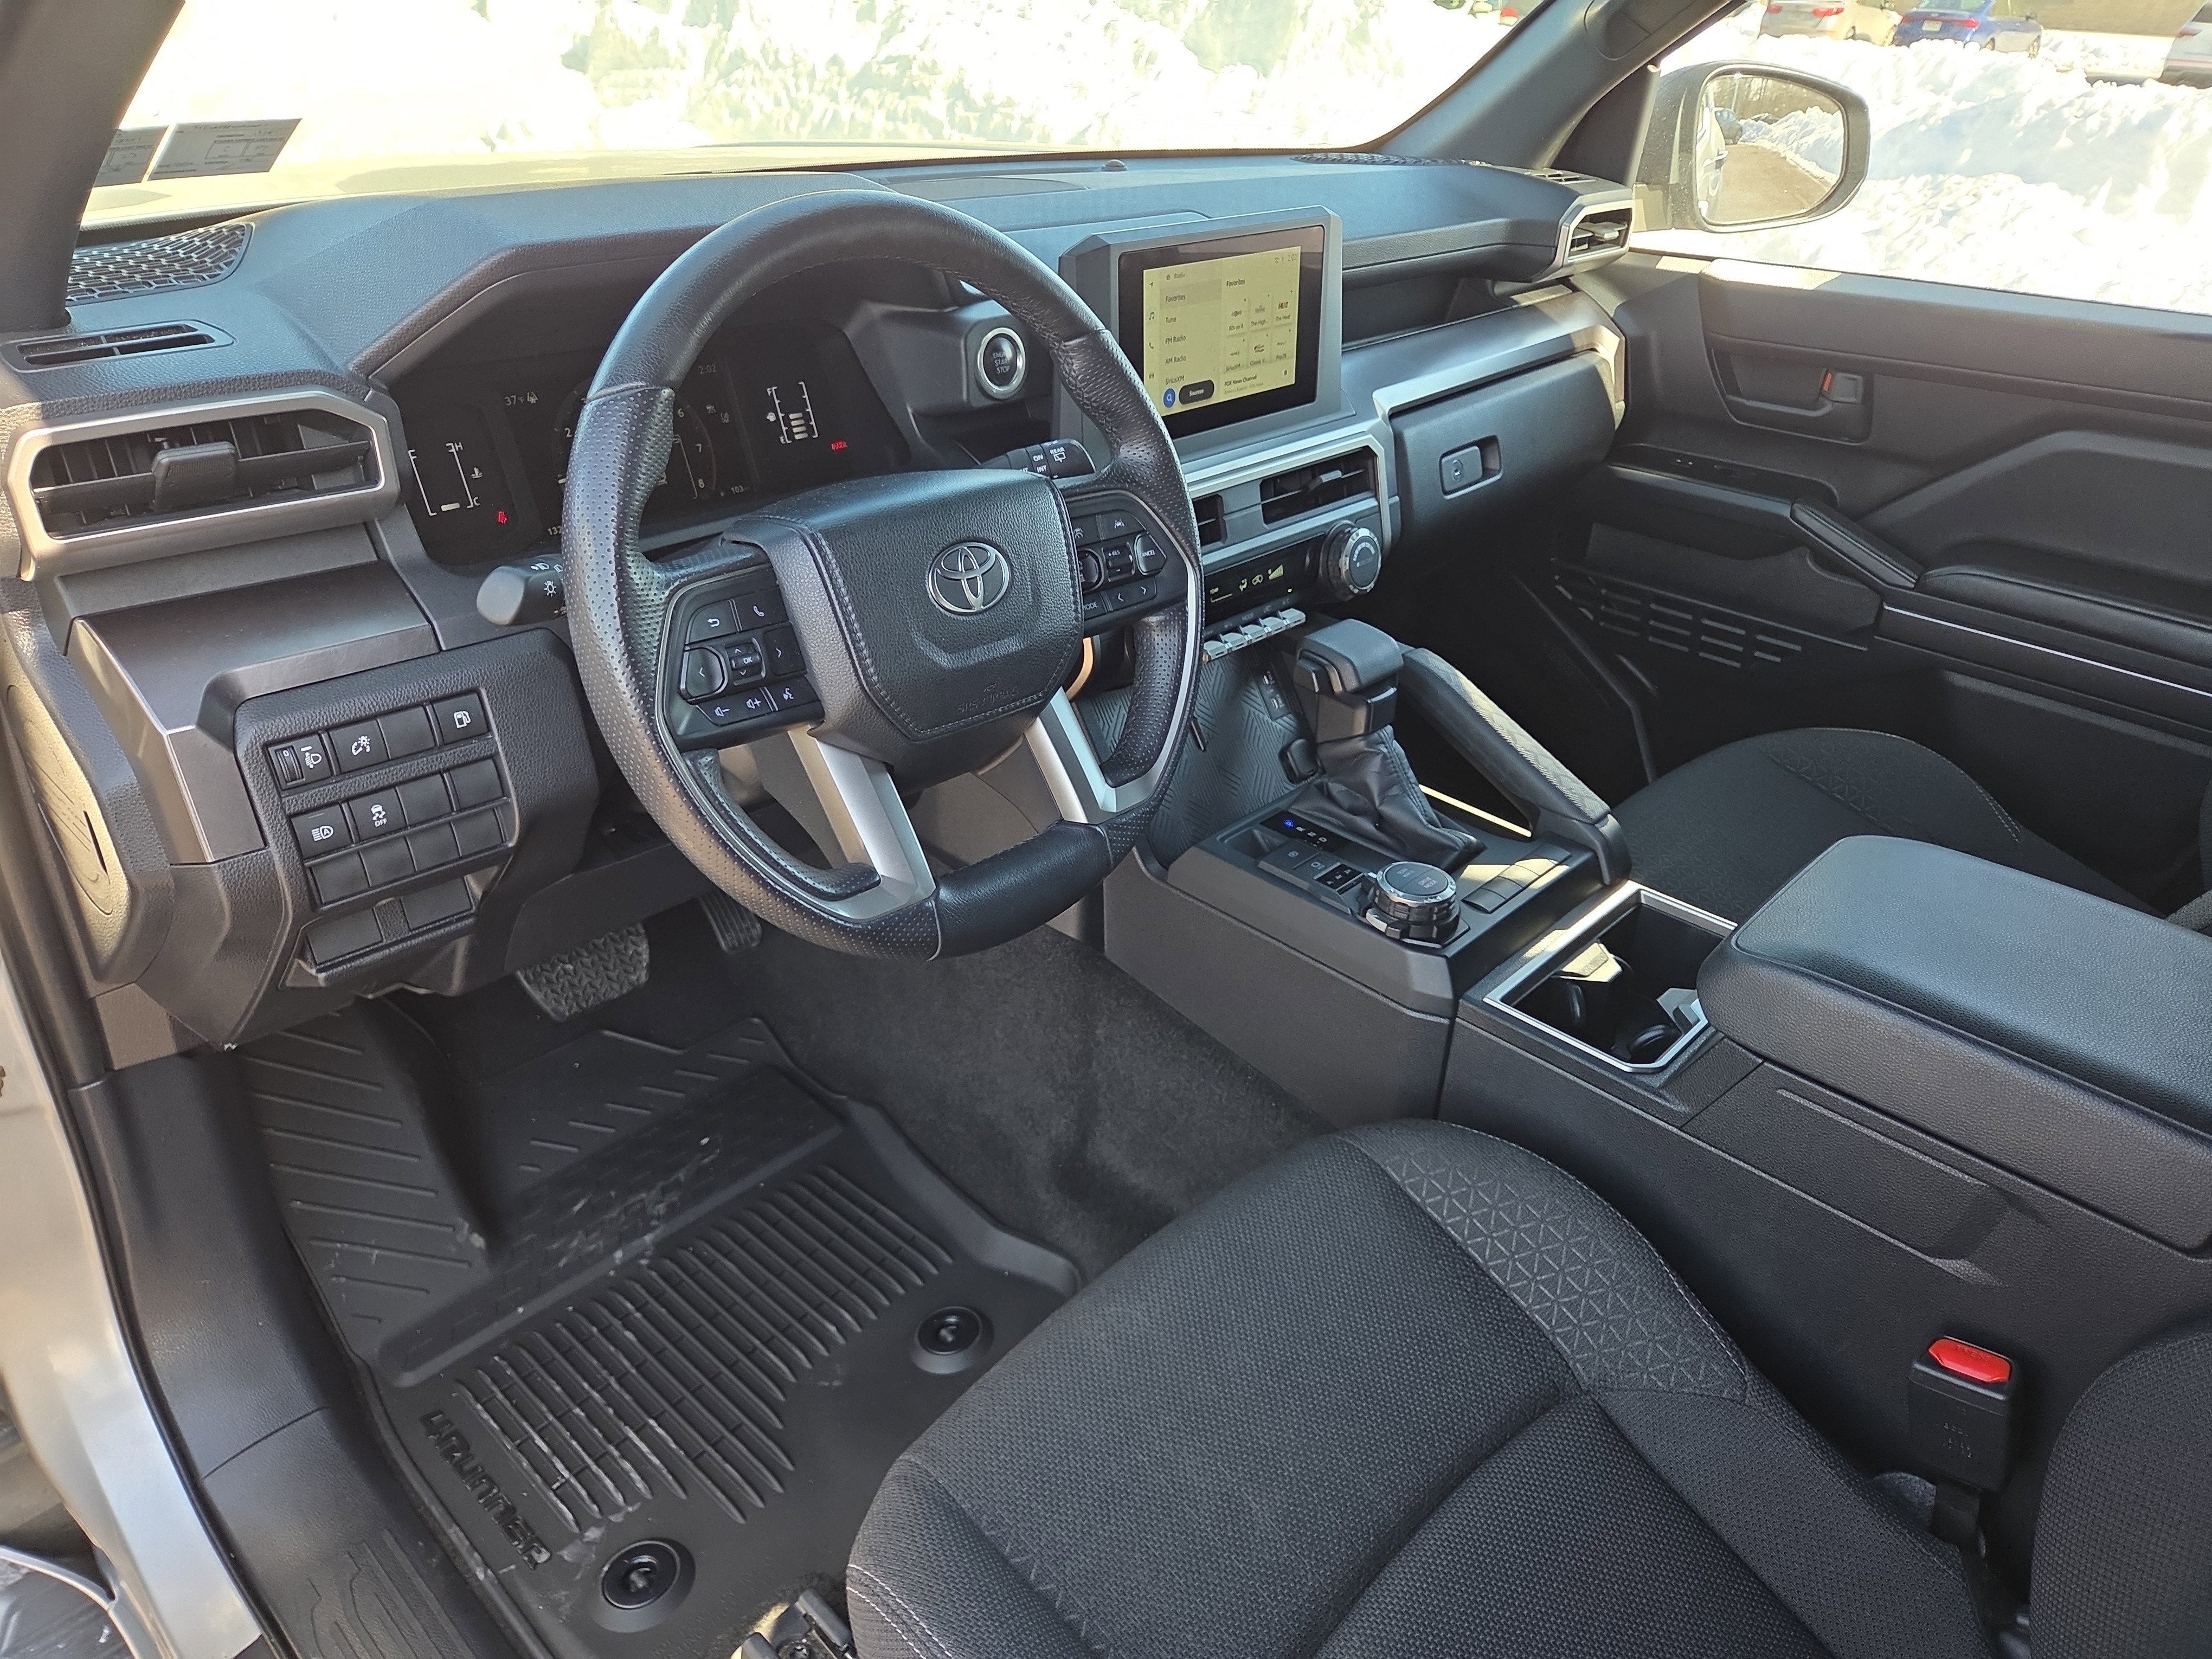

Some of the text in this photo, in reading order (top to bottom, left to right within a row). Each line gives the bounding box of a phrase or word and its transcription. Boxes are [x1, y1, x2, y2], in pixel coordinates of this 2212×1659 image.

[1226, 279, 1245, 287] Favorites
[1165, 294, 1186, 303] Favorites
[698, 364, 717, 374] 2:02
[996, 365, 1010, 374] STOP
[1165, 375, 1185, 385] SiriusXM
[678, 408, 685, 418] 6
[564, 427, 573, 438] 2
[454, 442, 464, 451] H
[696, 443, 702, 453] 7
[1037, 465, 1047, 473] INT
[698, 479, 705, 488] 8
[731, 485, 744, 494] 103
[473, 497, 481, 506] C
[1140, 549, 1156, 558] ANCEL
[374, 818, 387, 827] OFF
